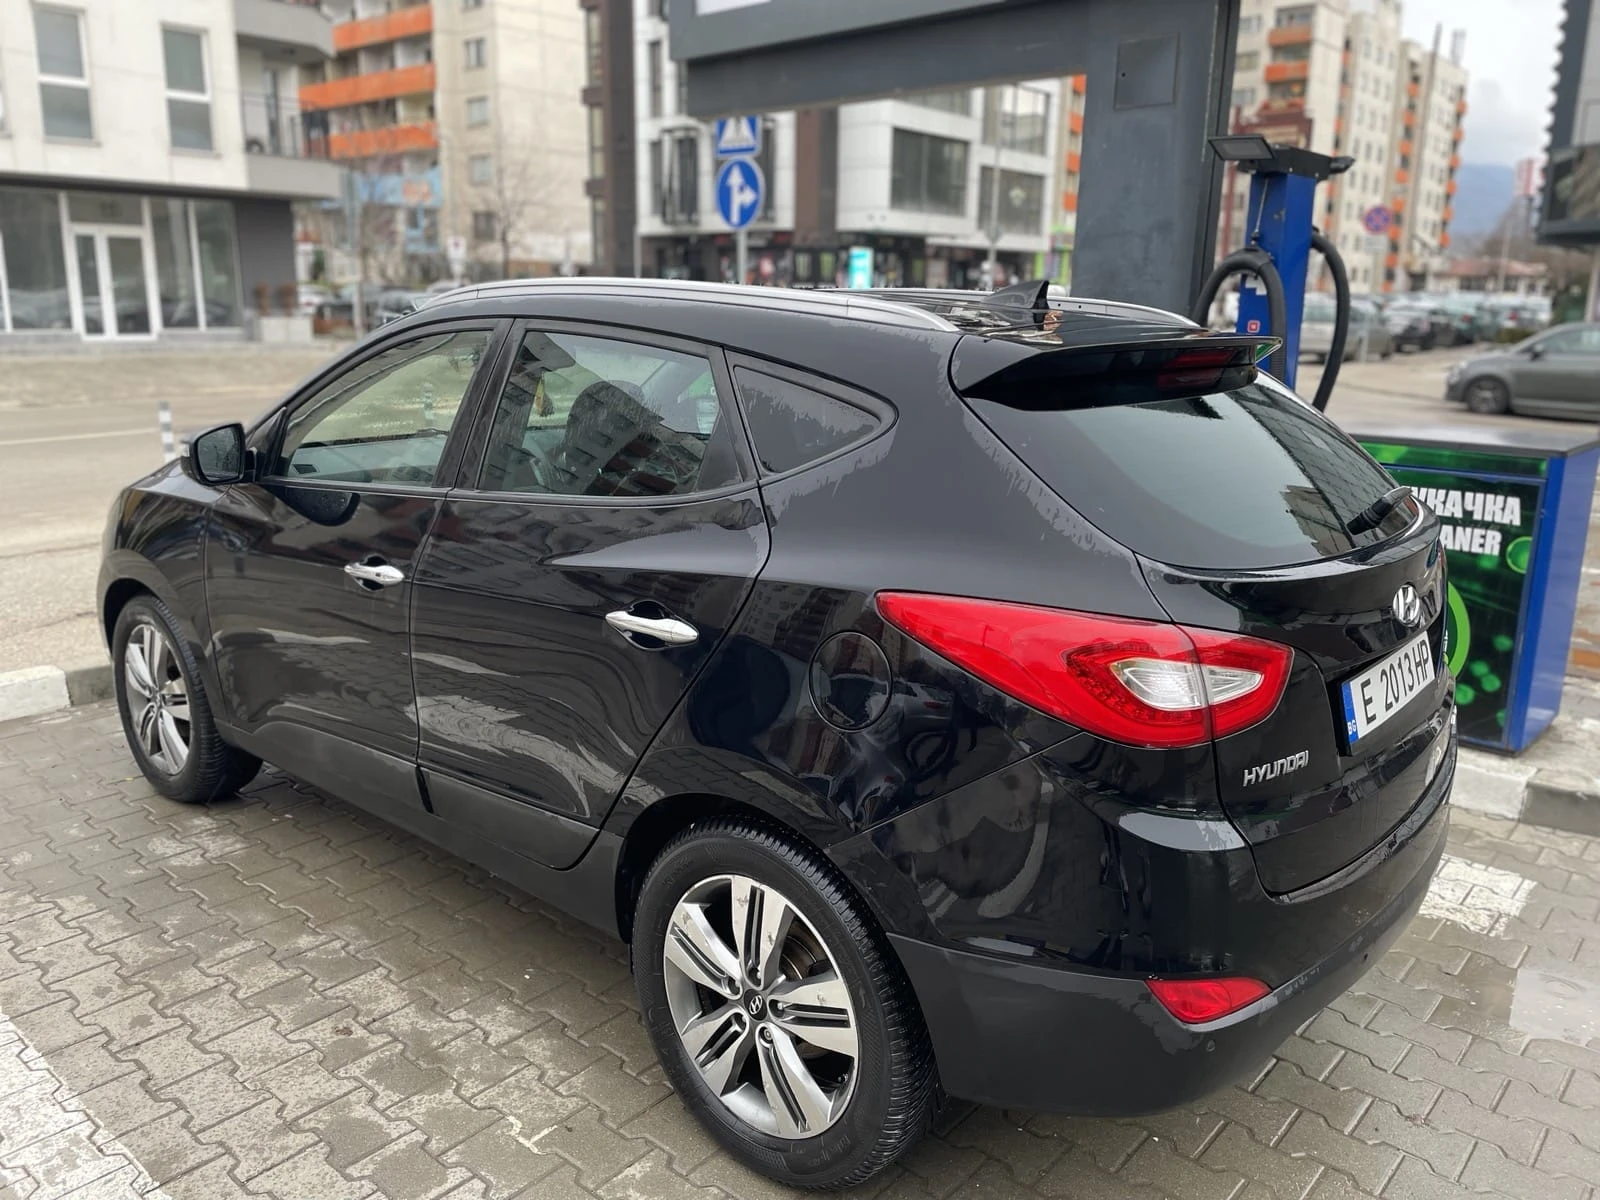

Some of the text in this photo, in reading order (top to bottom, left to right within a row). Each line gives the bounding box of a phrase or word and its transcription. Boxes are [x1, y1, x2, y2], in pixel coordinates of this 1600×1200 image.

[1439, 524, 1502, 556] ANER
[1360, 678, 1377, 726] E
[1347, 719, 1357, 735] BG
[1243, 749, 1309, 787] HYUNDAI
